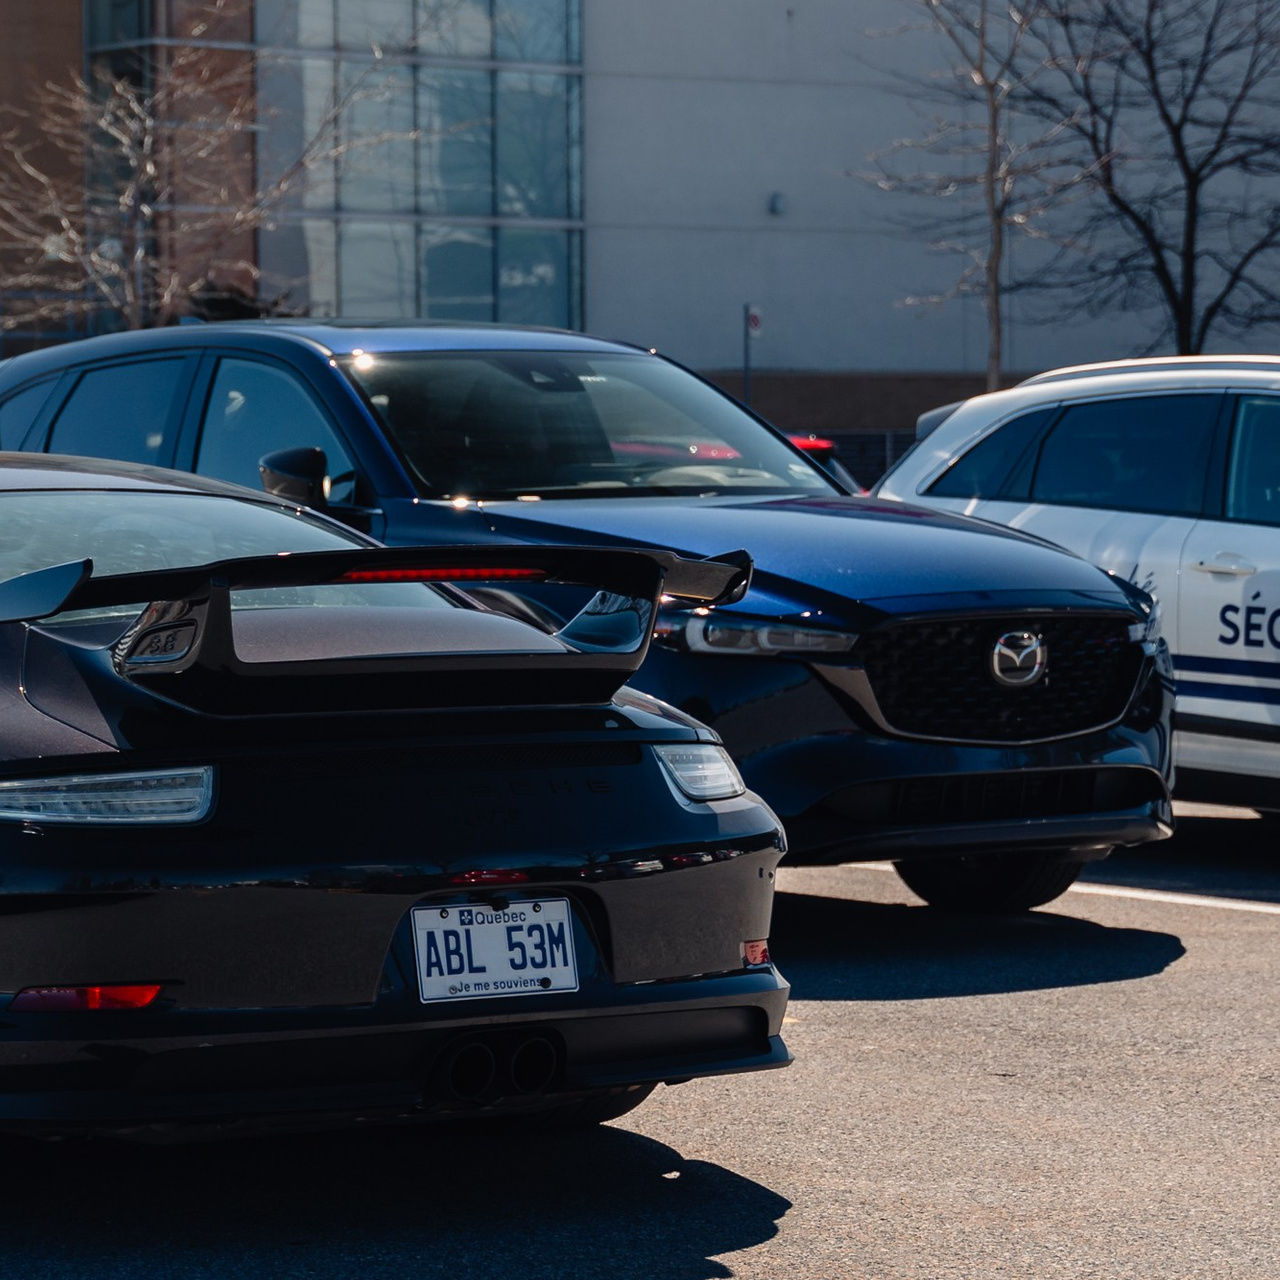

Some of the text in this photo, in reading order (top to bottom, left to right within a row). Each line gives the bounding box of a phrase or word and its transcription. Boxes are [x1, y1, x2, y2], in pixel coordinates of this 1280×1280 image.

[426, 921, 569, 978] ABL 53M
[458, 976, 542, 993] Je me souviens
